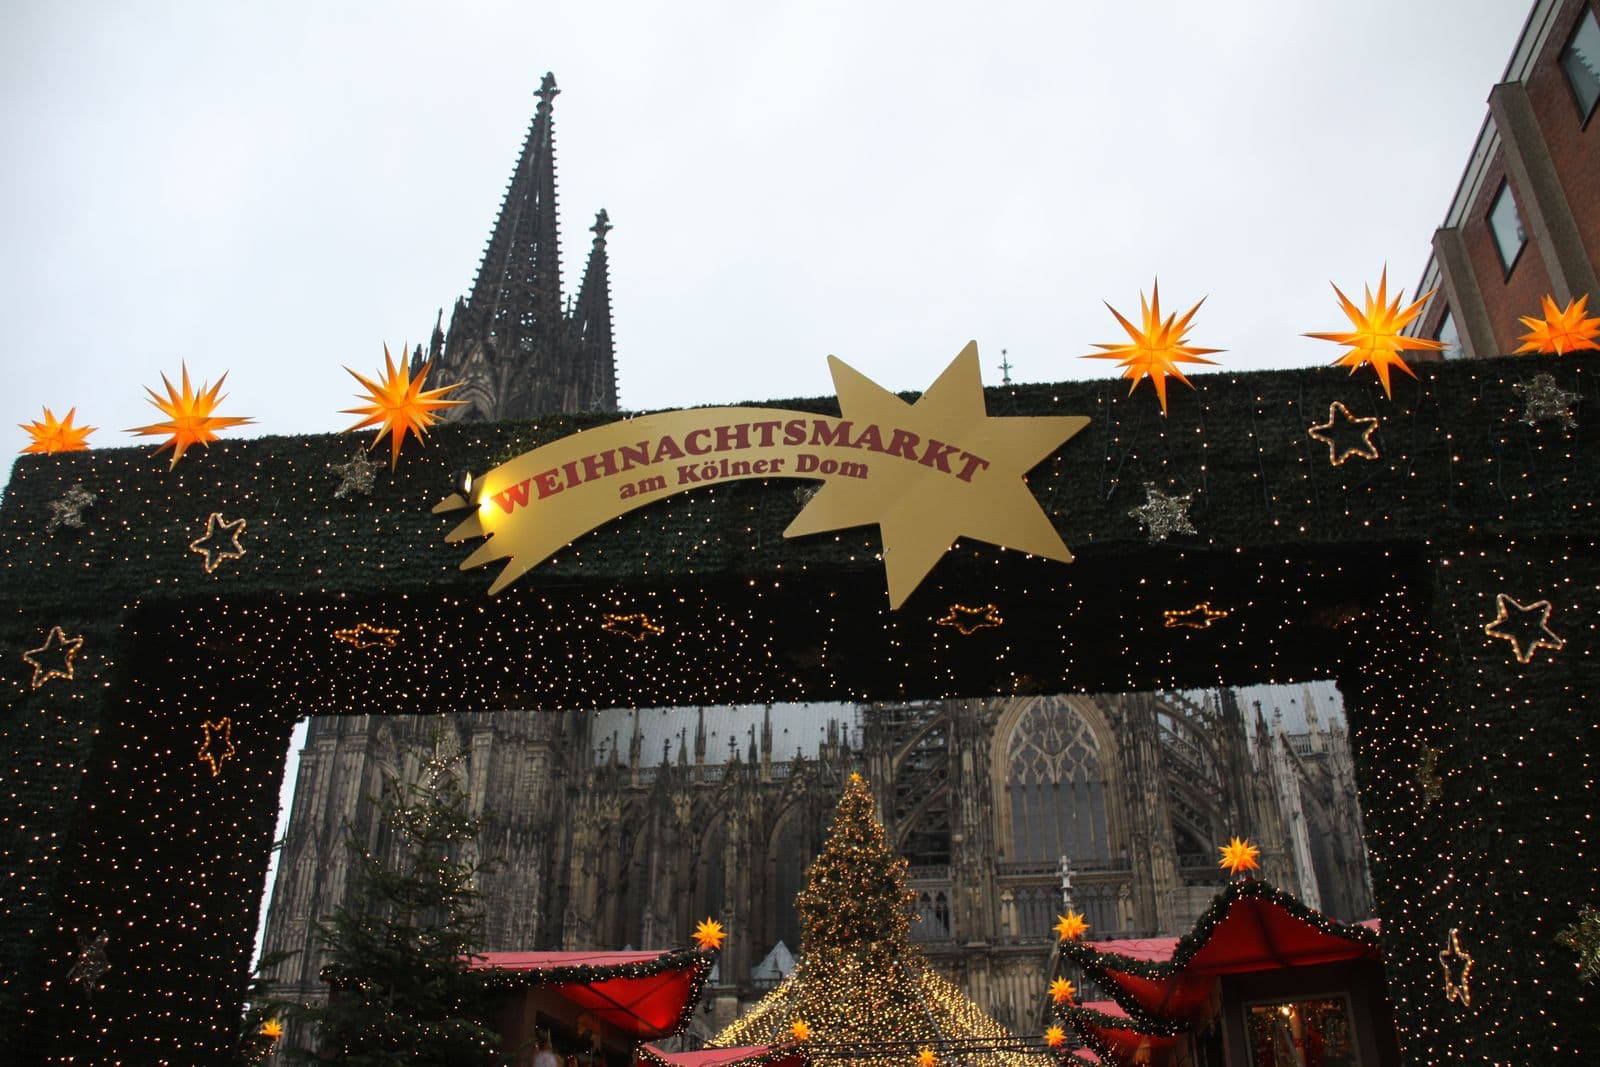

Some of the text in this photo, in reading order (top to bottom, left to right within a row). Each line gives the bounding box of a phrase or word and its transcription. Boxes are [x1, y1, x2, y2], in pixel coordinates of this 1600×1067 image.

[491, 419, 990, 515] WEIHNACHTSMARKT
[619, 453, 869, 500] am Kölner Dom
